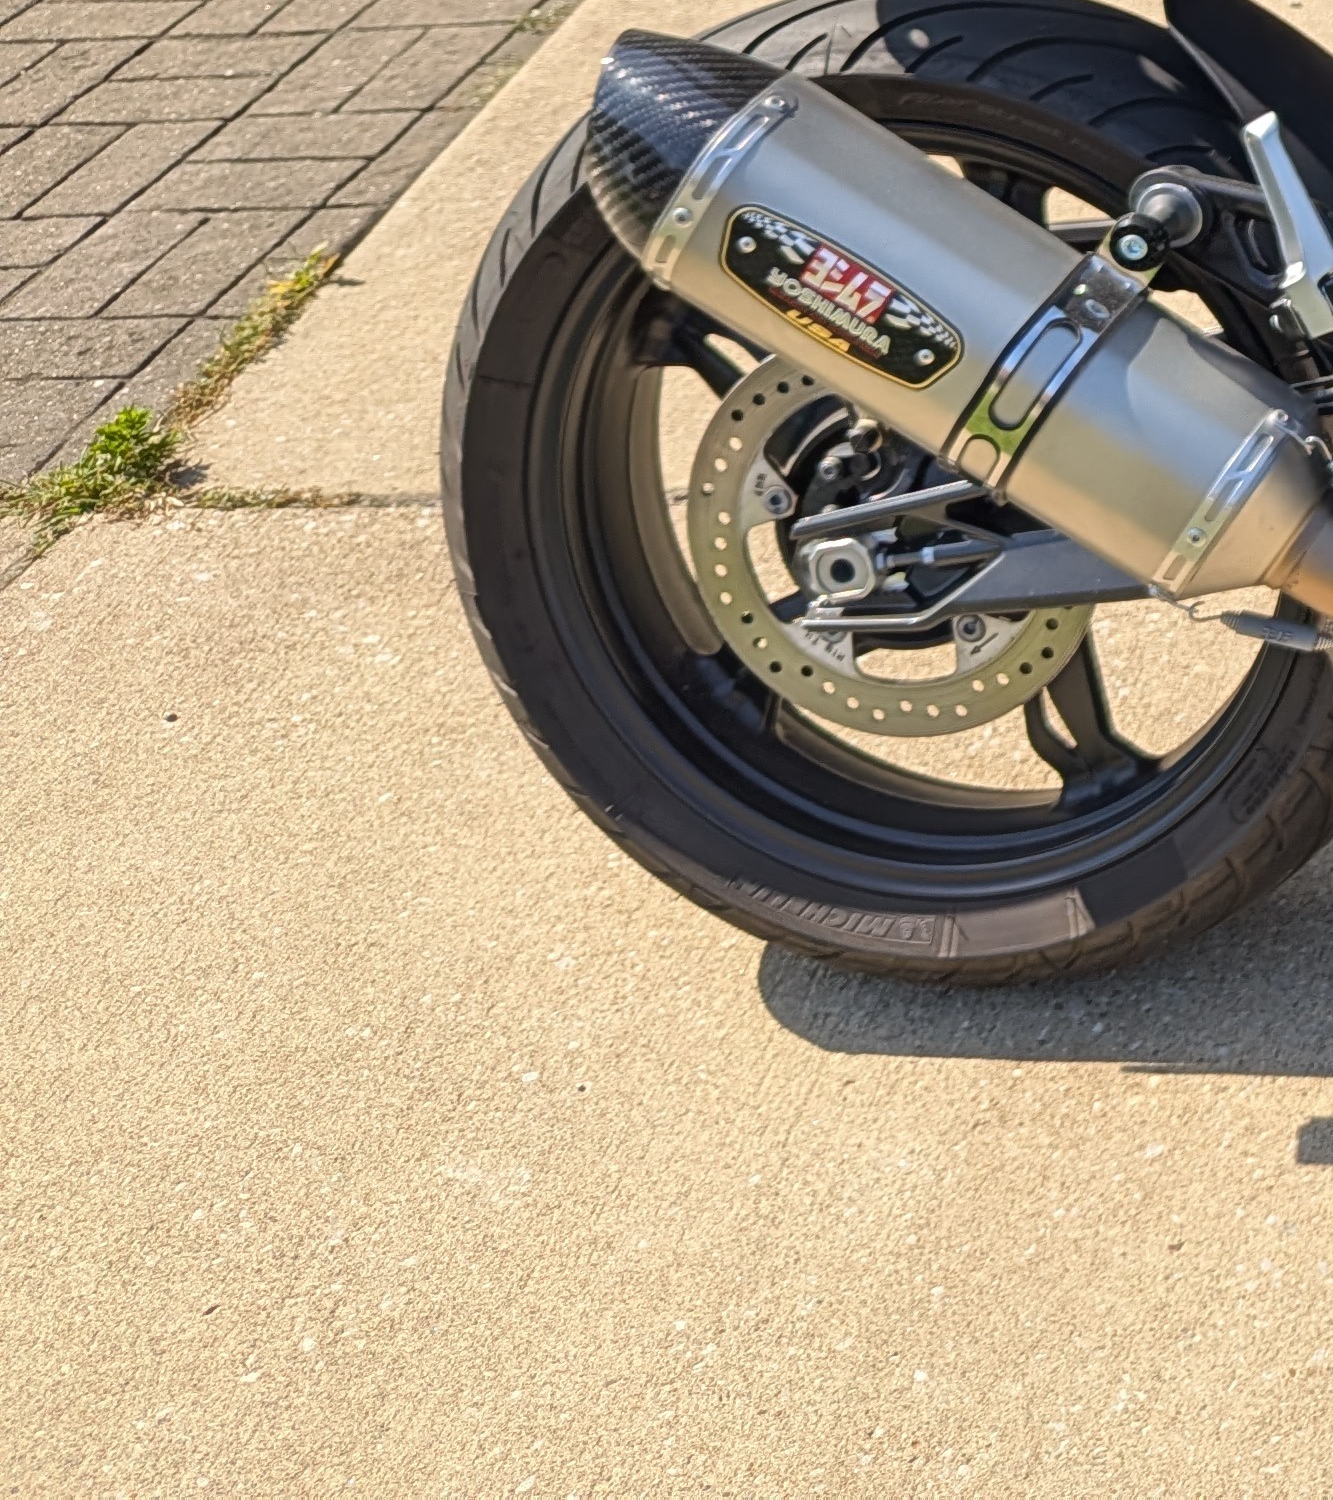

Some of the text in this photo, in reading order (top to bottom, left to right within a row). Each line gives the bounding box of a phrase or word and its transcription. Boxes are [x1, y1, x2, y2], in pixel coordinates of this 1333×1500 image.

[766, 266, 892, 356] YOSHIMURA
[802, 246, 892, 320] ヨシムラ
[785, 309, 851, 352] USA
